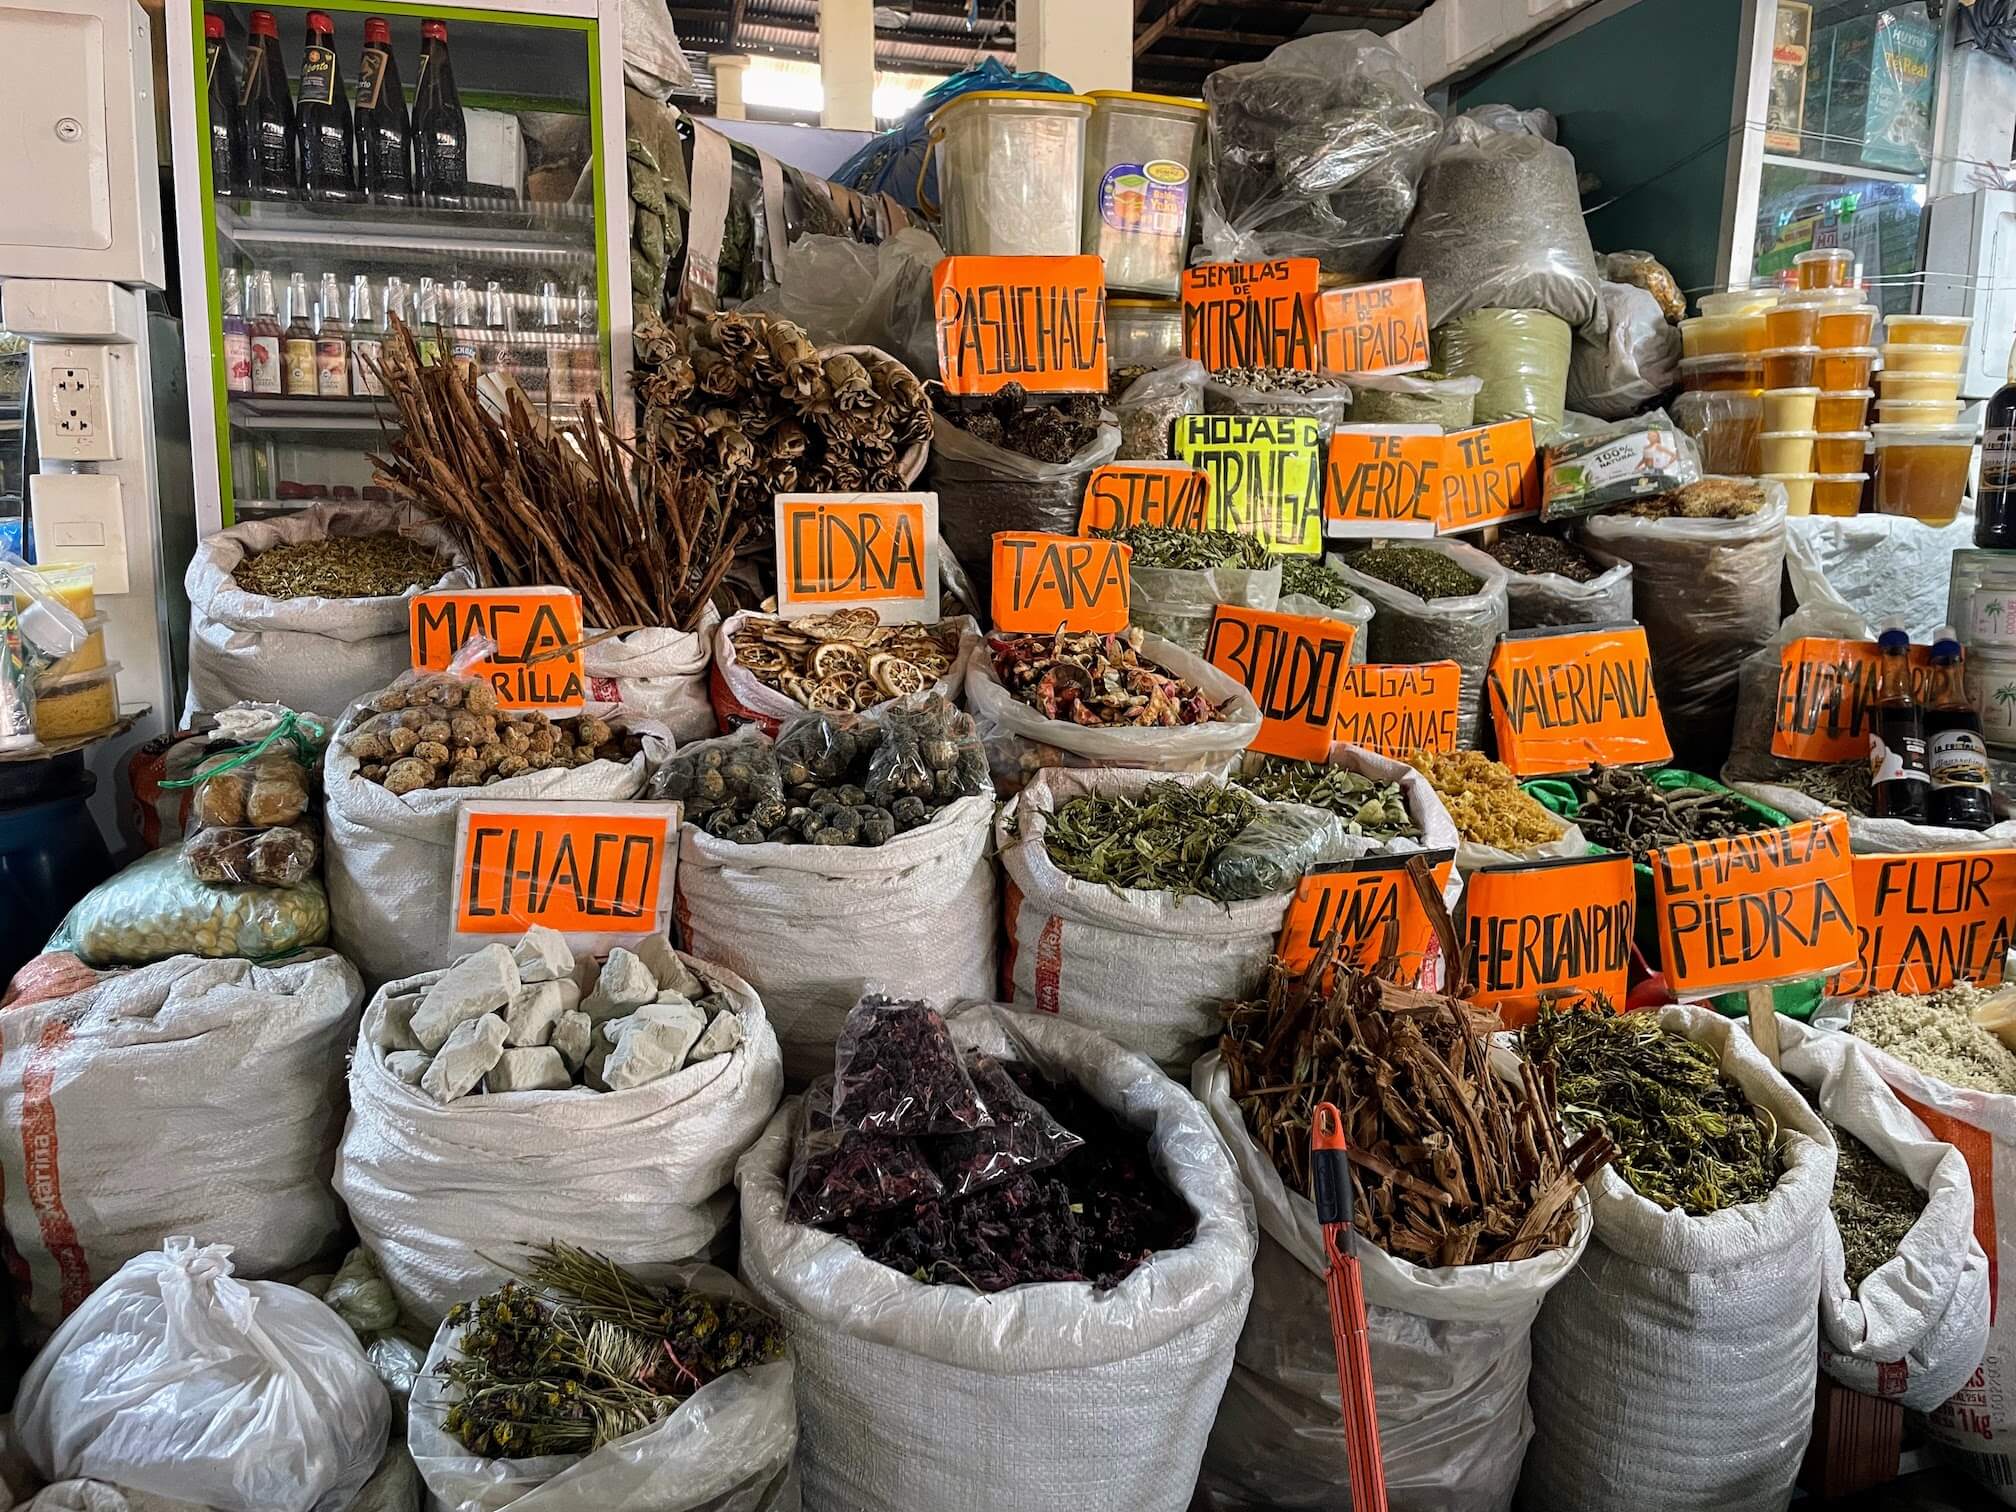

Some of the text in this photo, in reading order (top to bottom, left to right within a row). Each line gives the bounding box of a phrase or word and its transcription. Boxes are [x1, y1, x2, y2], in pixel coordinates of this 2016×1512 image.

[1903, 57, 1928, 79] Real
[1191, 261, 1289, 289] SEMILLAS
[1233, 284, 1251, 295] DE
[1341, 288, 1394, 313] FLOR
[941, 286, 1106, 379] PASUCHACA
[1184, 292, 1318, 373] MORINGA
[1320, 314, 1429, 373] COPAIBA
[1357, 308, 1373, 322] DE
[1189, 416, 1296, 445] HOJAS
[1369, 435, 1402, 455] TE
[1457, 430, 1494, 467] TÉ
[1595, 445, 1633, 463] 100%
[1088, 472, 1207, 535] STEVIA
[1192, 451, 1320, 545] ORINGA
[1332, 461, 1439, 522] VERDE
[1441, 461, 1524, 523] PURO
[791, 505, 923, 594] CIDRA
[1003, 541, 1129, 611] TARA
[418, 602, 575, 665] MACA
[491, 666, 586, 703] RILLA
[1209, 617, 1346, 725] BOLDO
[1342, 666, 1436, 699] ALGAS
[1489, 649, 1656, 735] VALERIANA
[1332, 705, 1456, 758] MARINAS
[467, 828, 654, 918] CHACO
[1874, 857, 1994, 917] FLOR
[1308, 875, 1398, 948] UÑA
[1667, 878, 1856, 979] PIEDRA
[1337, 942, 1365, 968] DE
[1831, 916, 2010, 996] BLANCA
